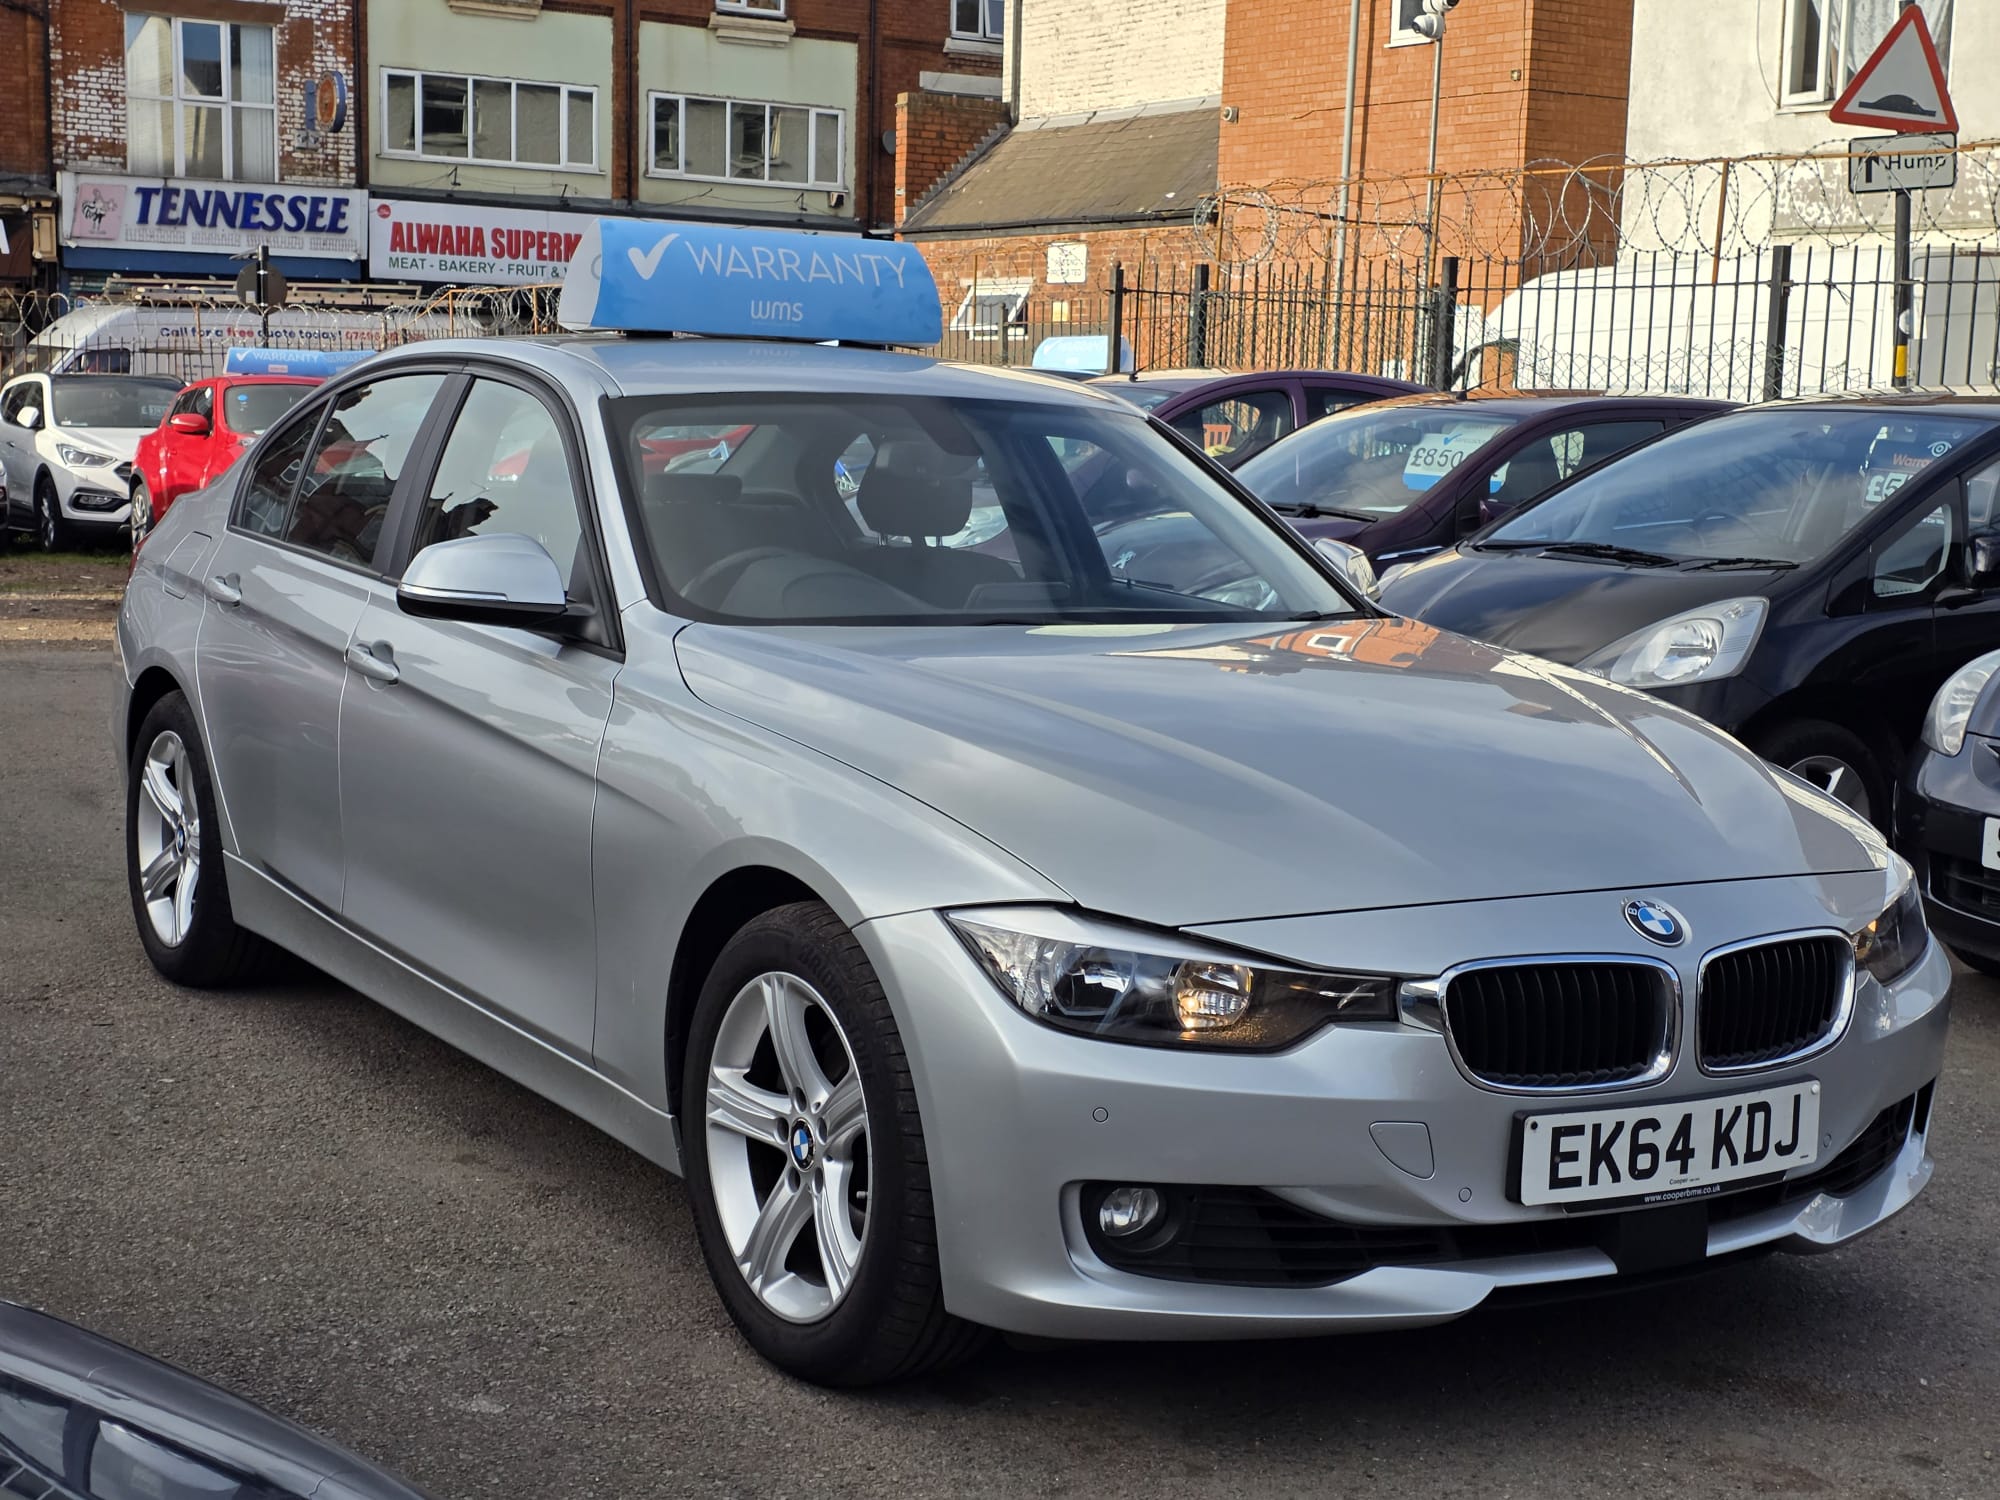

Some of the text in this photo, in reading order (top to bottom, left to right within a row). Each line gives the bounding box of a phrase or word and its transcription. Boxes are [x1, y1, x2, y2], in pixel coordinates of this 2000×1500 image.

[1888, 152, 1946, 171] Hump
[134, 186, 350, 234] TENNESSEE
[389, 221, 486, 258] ALWAHA
[388, 256, 427, 270] MEAT
[438, 259, 496, 274] BAKERY
[507, 263, 547, 278] FRUIT
[550, 266, 560, 278] &
[684, 240, 906, 289] WARRANTY
[750, 299, 804, 322] wms
[160, 326, 188, 337] Call
[253, 350, 319, 363] WARRANTY
[1865, 472, 1913, 502] £5
[1627, 900, 1666, 916] BMW
[1549, 1093, 1802, 1190] EK64 KDJ
[1643, 1184, 1721, 1203] www.cooperbmw.co.uk
